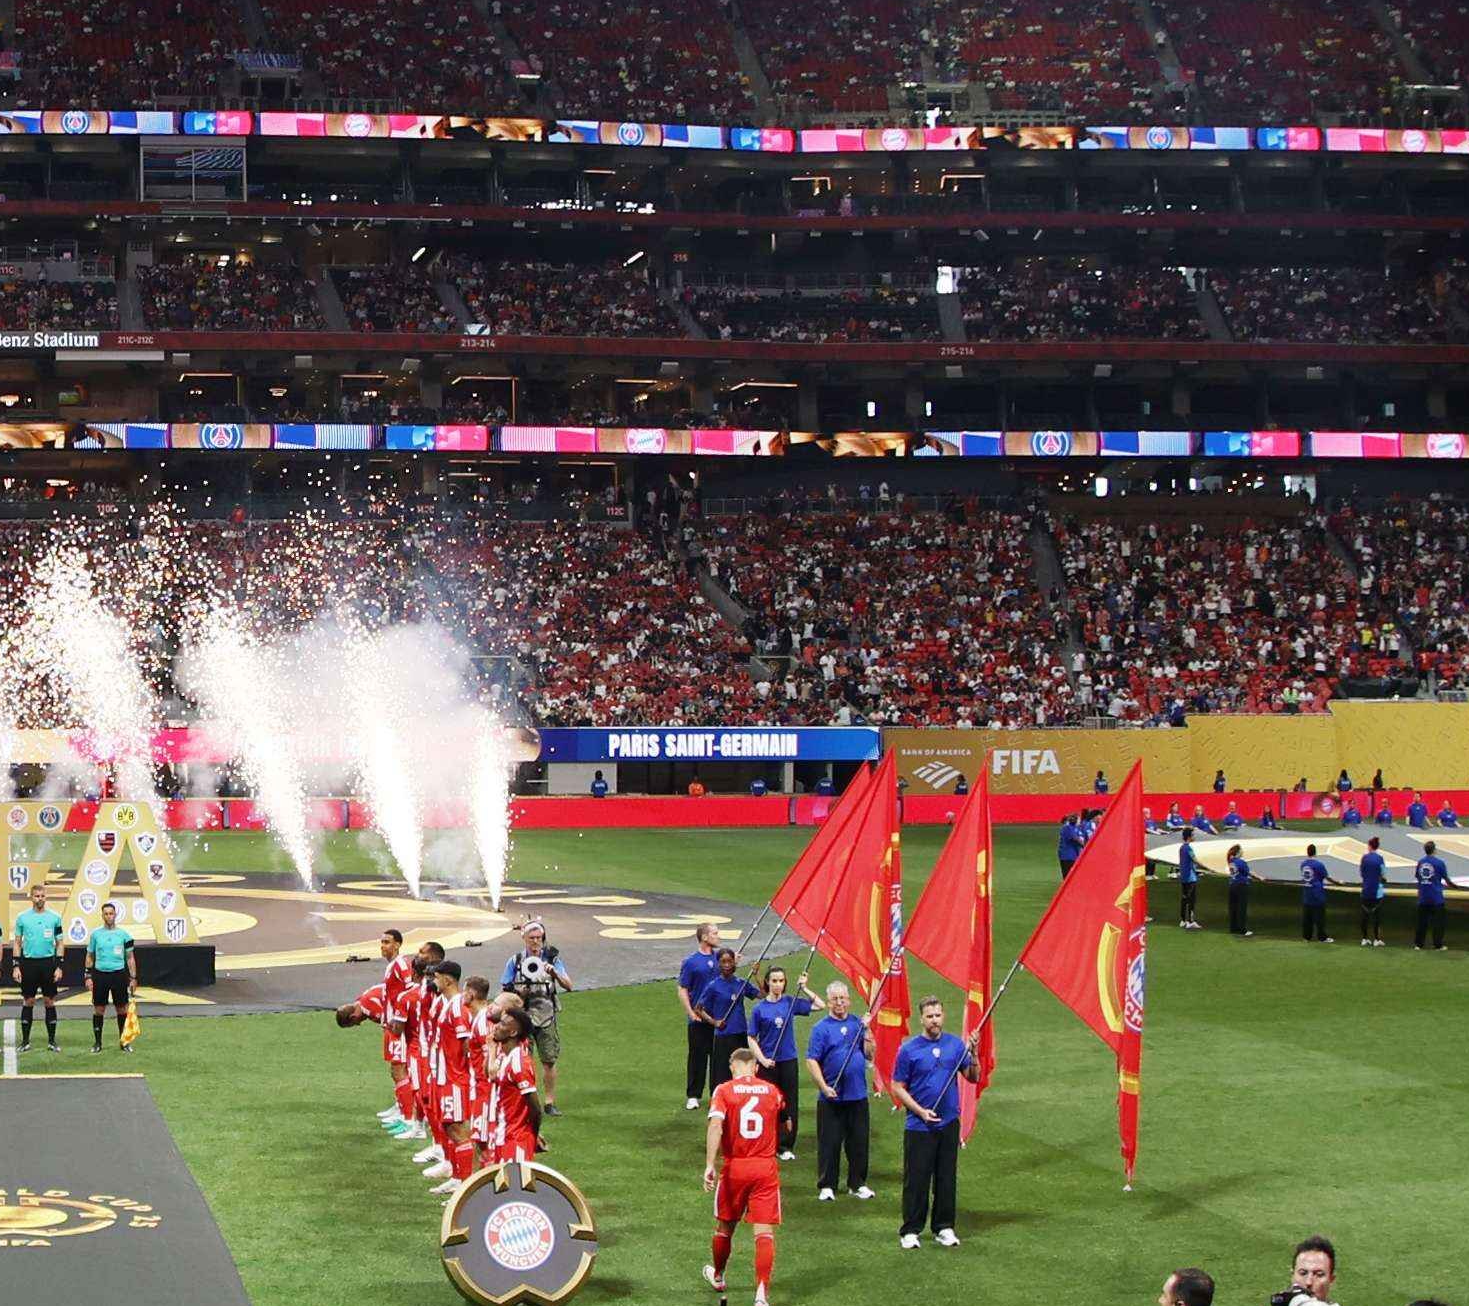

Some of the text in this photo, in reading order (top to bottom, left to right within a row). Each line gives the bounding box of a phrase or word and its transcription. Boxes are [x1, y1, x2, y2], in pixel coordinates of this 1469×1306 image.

[33, 331, 99, 347] Stadium
[117, 336, 154, 346] 211C-212C
[605, 506, 625, 517] 112C
[608, 733, 798, 757] PARIS SAINT-GERMAIN
[930, 748, 971, 756] AMERICA
[992, 748, 1060, 775] FIFA
[739, 1096, 763, 1139] 6
[88, 1195, 153, 1211] CUP
[128, 1215, 162, 1229] 25
[489, 1205, 549, 1235] FC BAYERN
[491, 1239, 552, 1266] MÜNCHEN
